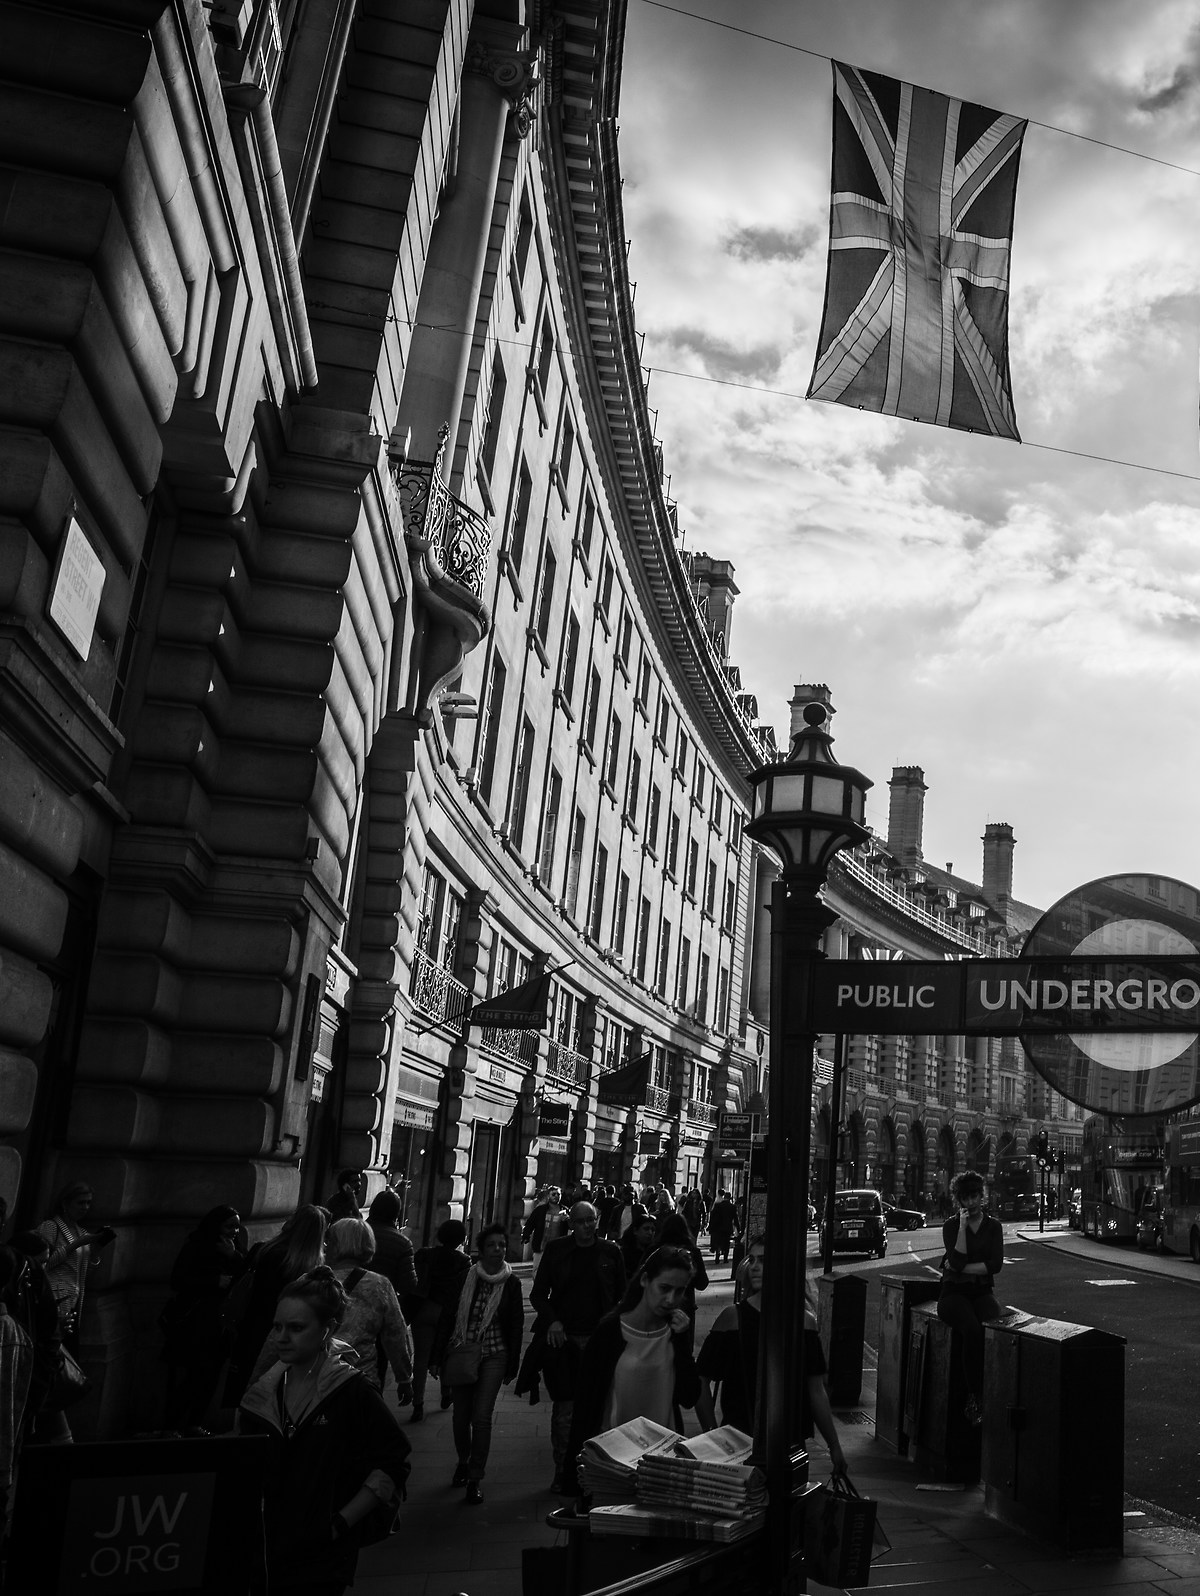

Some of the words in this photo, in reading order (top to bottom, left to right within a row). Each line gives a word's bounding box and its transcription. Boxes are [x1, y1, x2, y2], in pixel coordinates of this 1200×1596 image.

[65, 556, 89, 602] STREET
[837, 984, 935, 1009] PUBLIC
[480, 1011, 502, 1020] THE
[504, 1013, 540, 1022] STING
[541, 1117, 552, 1125] The
[553, 1117, 568, 1127] Sting
[93, 1492, 189, 1539] JW
[81, 1542, 181, 1578] .ORG
